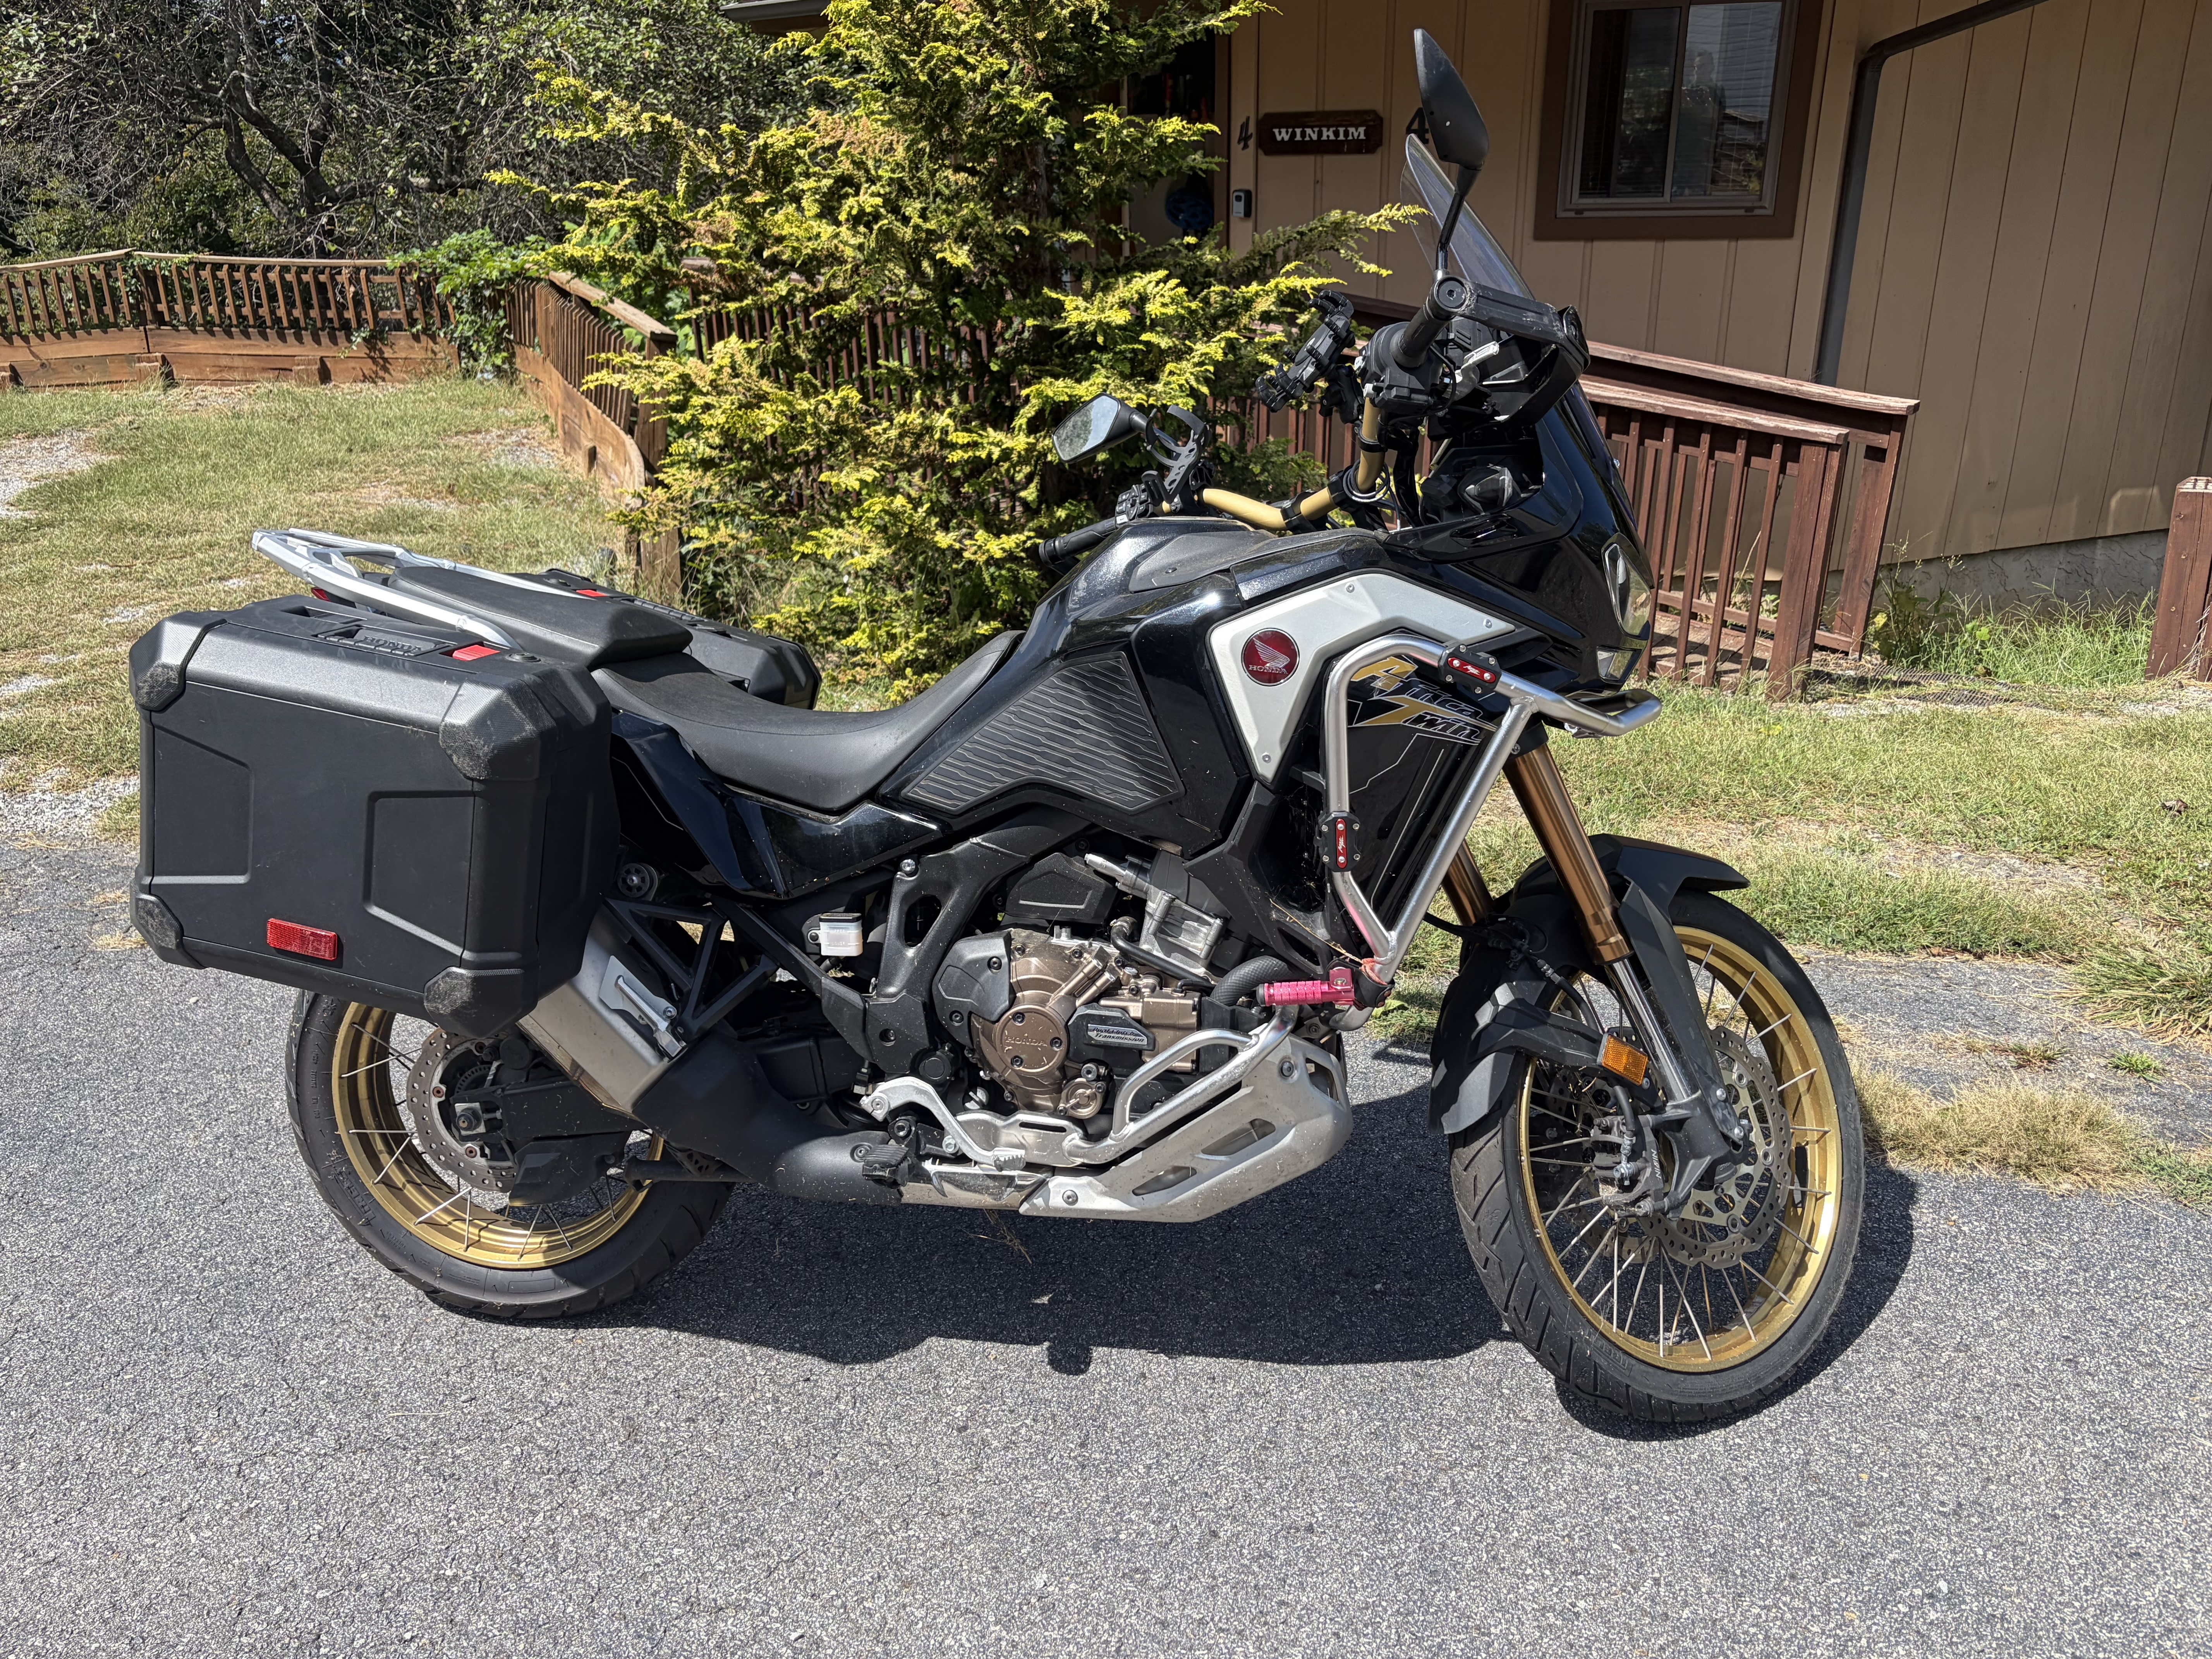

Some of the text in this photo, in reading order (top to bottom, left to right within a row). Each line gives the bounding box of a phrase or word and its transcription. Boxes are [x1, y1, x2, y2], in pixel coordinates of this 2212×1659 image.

[1405, 107, 1429, 144] 4
[1237, 116, 1253, 151] 4
[1273, 126, 1366, 141] WINKIM
[364, 635, 422, 652] HONDA
[1249, 665, 1288, 674] HONDA
[1005, 1037, 1048, 1047] HONDA
[1094, 1033, 1144, 1042] Transmission
